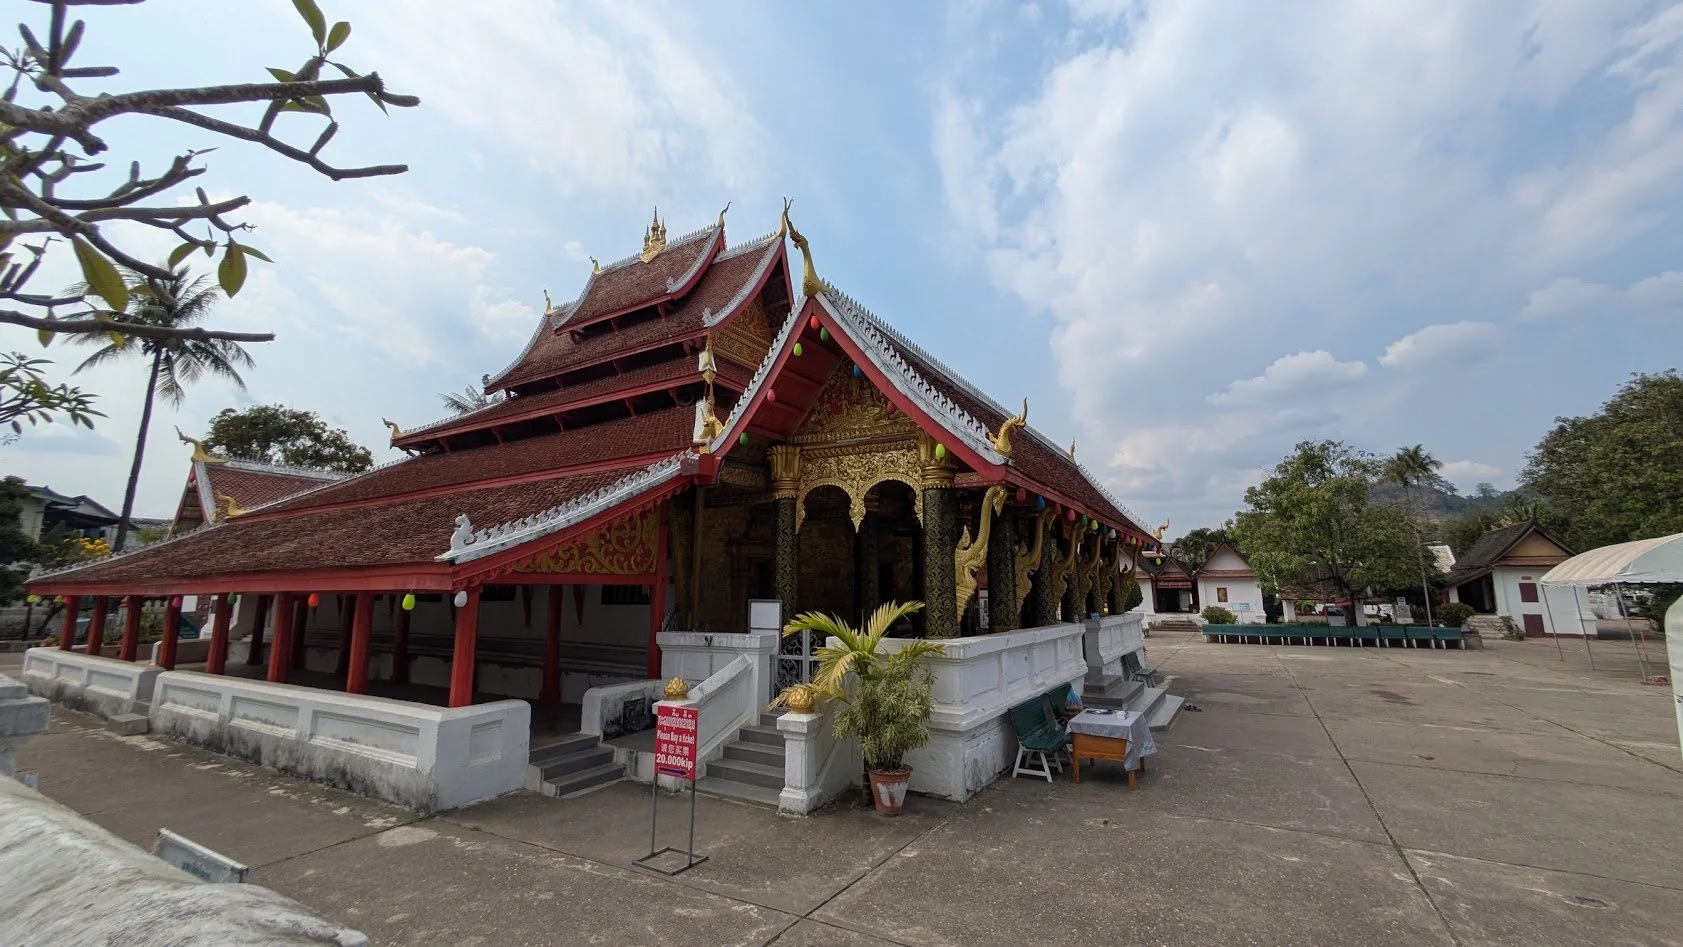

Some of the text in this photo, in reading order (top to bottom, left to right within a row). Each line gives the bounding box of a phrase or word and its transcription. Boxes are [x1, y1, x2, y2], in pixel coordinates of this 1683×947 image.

[657, 729, 670, 741] Please
[679, 734, 682, 742] a
[682, 733, 694, 744] ticket
[661, 743, 689, 756] 请您买票
[656, 753, 693, 770] 20.000kip
